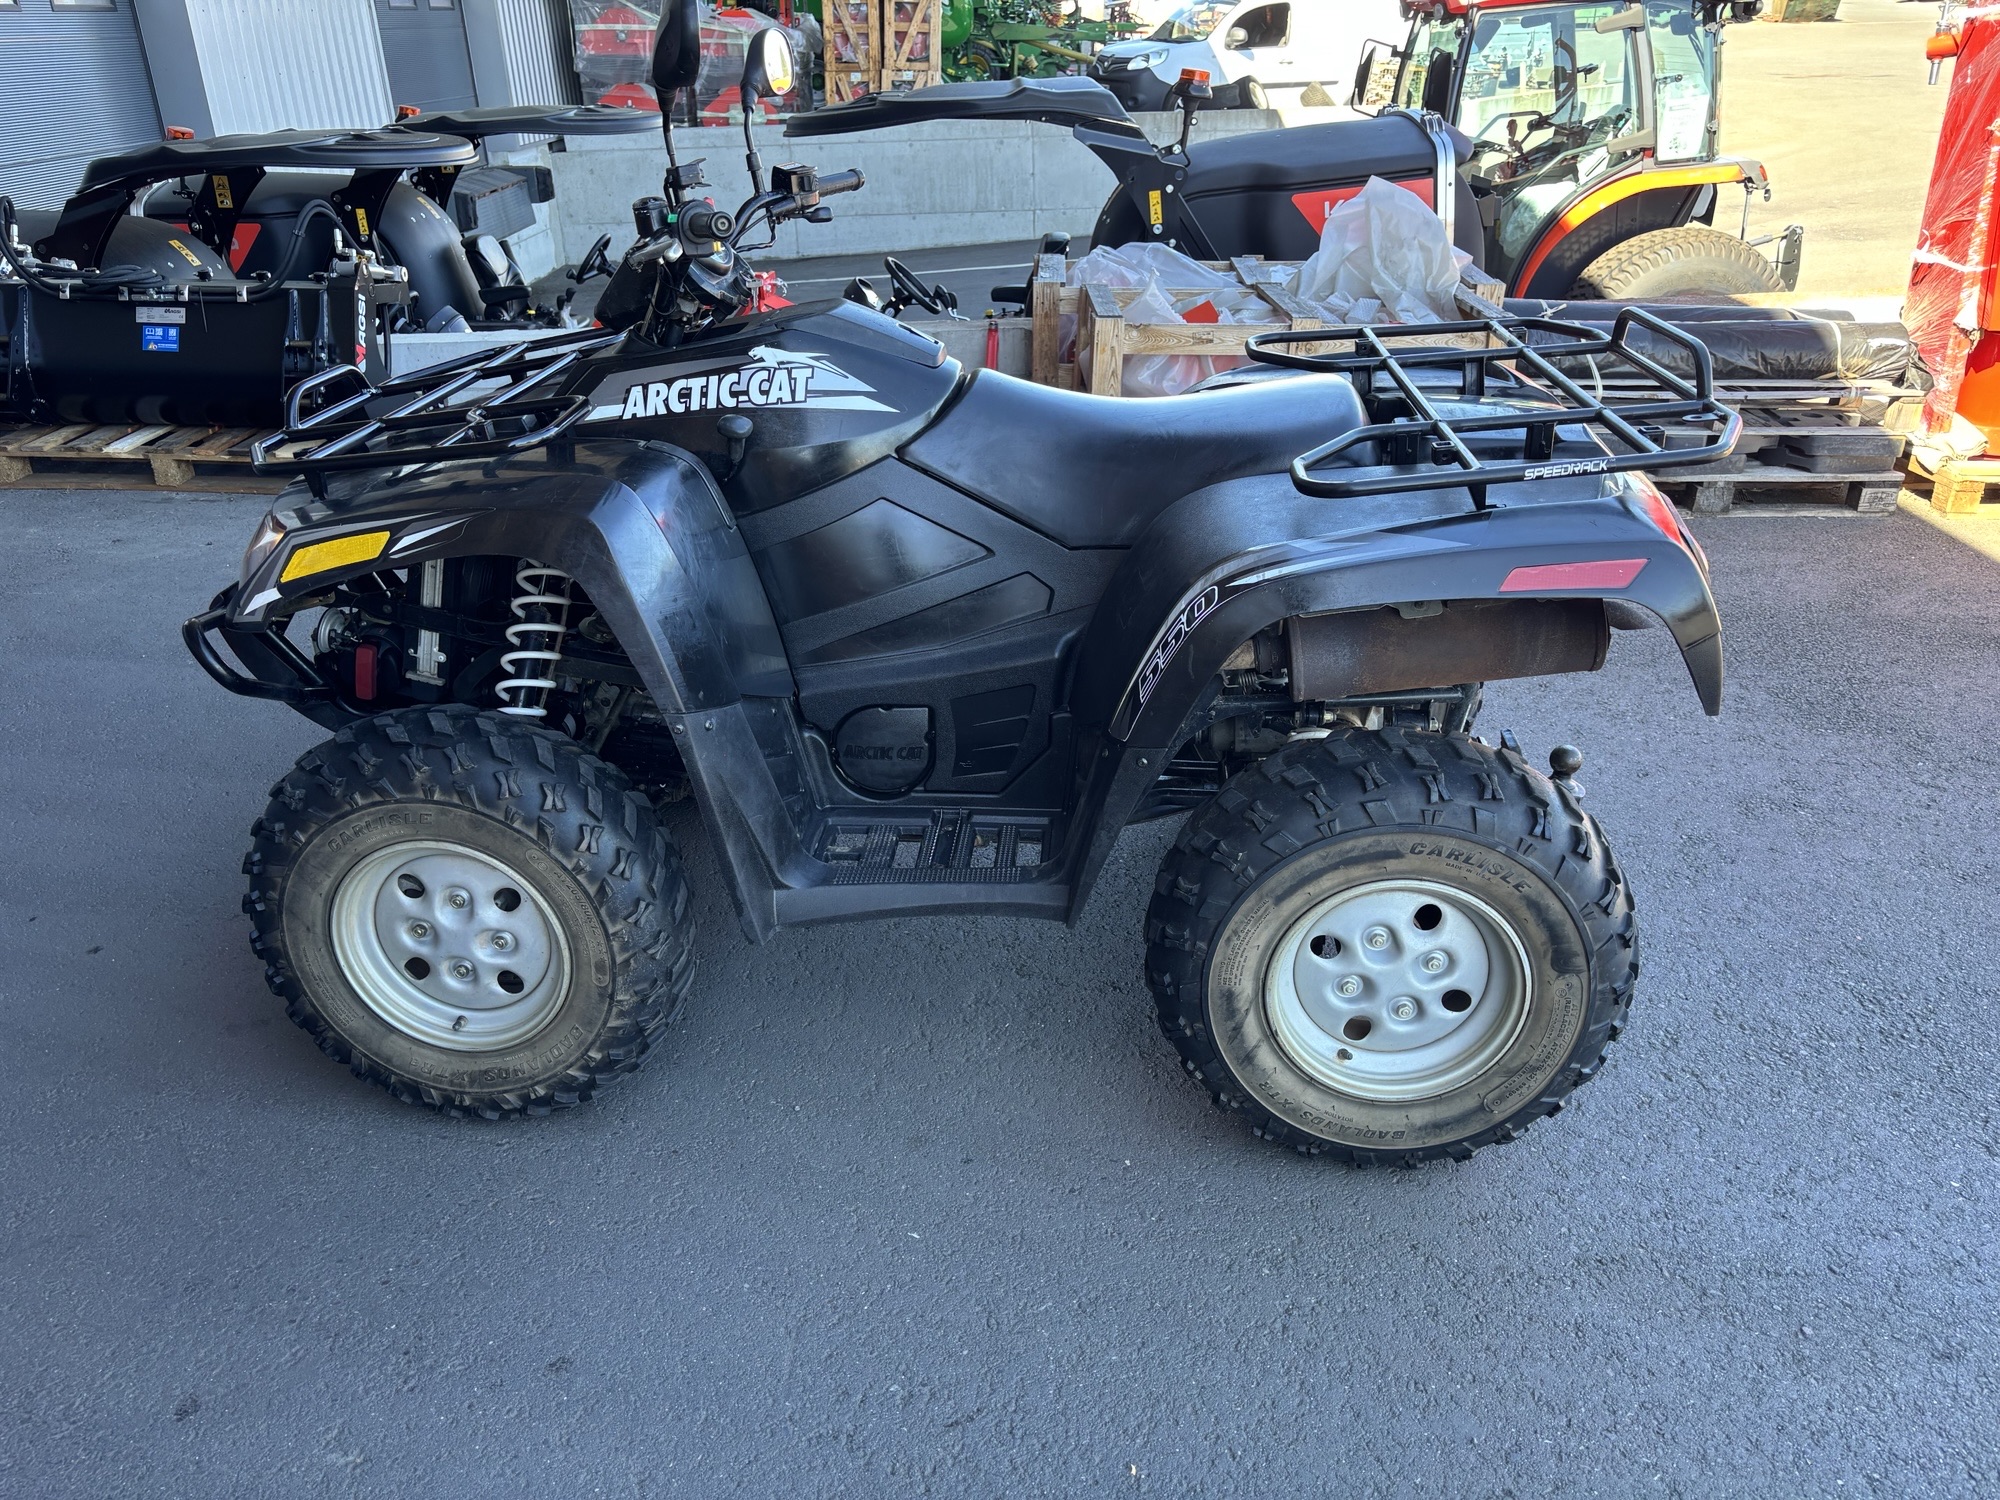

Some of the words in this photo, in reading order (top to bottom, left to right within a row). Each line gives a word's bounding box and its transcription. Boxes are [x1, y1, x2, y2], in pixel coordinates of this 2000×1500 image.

[355, 293, 367, 373] MAGSI
[1523, 460, 1608, 481] SPEEDRACK
[1138, 585, 1219, 704] 550
[842, 744, 894, 761] ARCTIC
[897, 745, 925, 761] CAT
[327, 811, 433, 854] CARLISLE
[1408, 842, 1533, 894] CARLISLE
[1445, 862, 1463, 871] MADE
[484, 1023, 584, 1082] BADLANDS
[1259, 1080, 1296, 1108] XTR
[1300, 1110, 1406, 1140] BADLANDS
